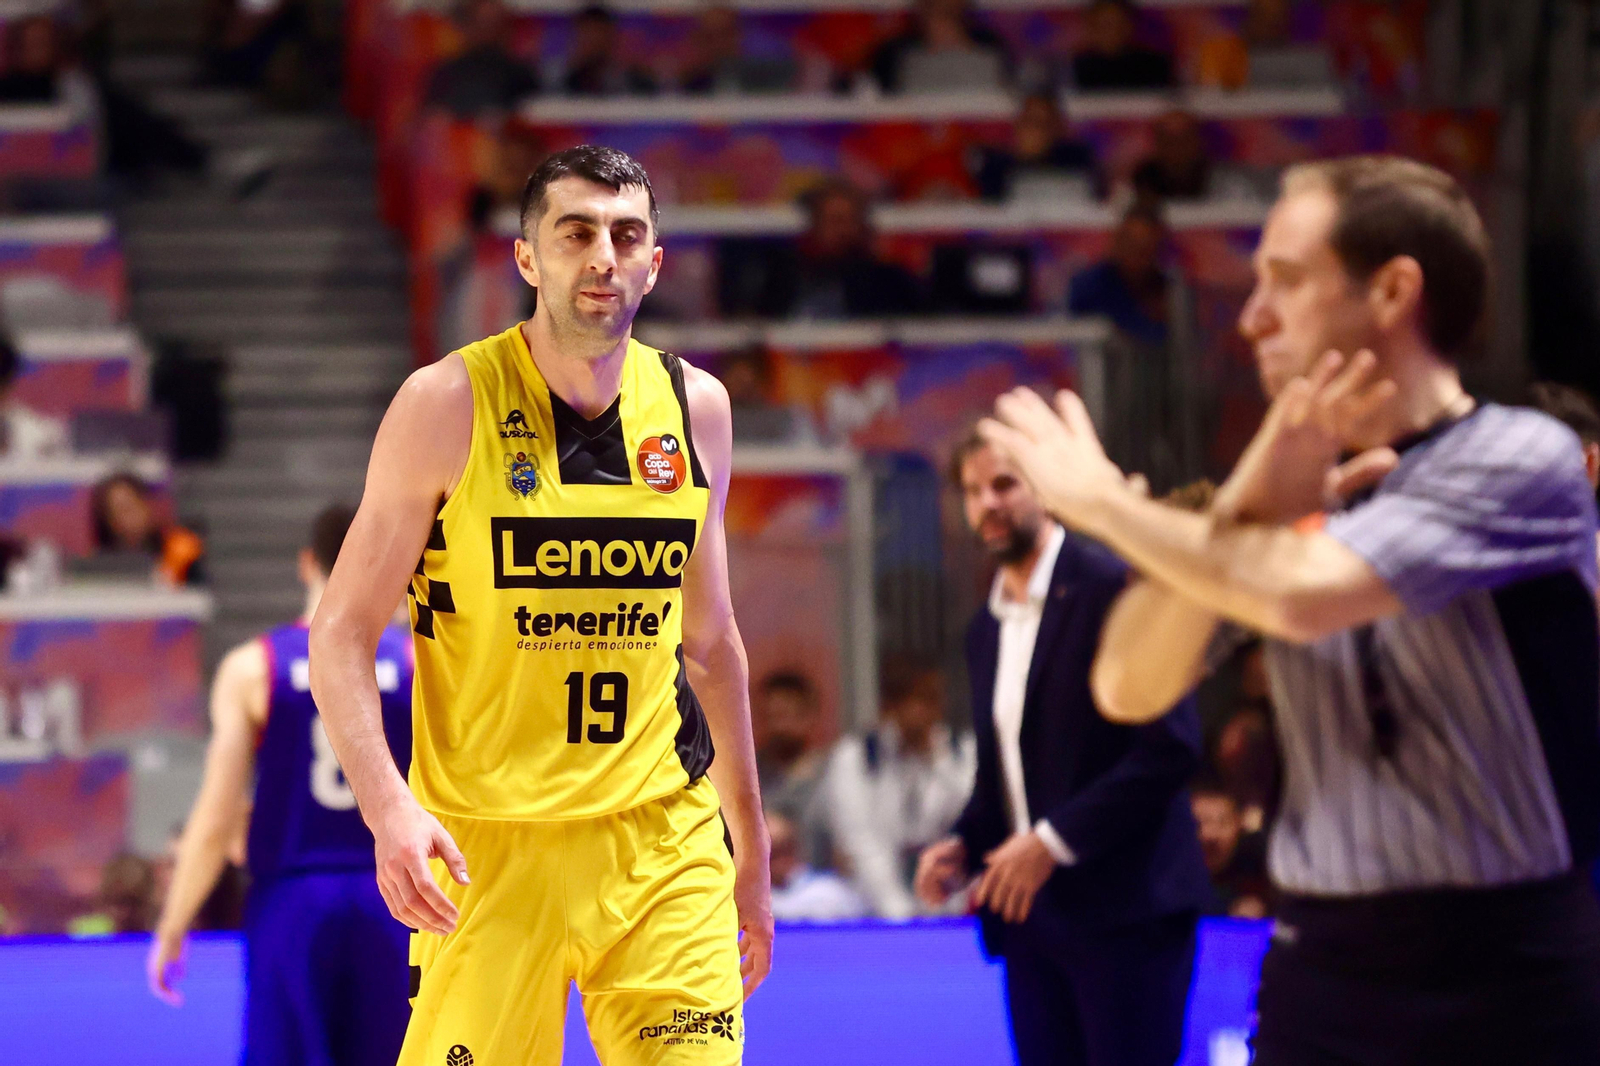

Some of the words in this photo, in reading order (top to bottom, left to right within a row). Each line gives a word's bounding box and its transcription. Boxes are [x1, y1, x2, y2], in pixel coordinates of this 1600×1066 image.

[644, 459, 670, 469] Copa
[658, 468, 675, 479] Rey
[502, 530, 688, 577] Lenovo
[517, 638, 581, 652] despierta
[564, 671, 629, 744] 19
[673, 1009, 711, 1023] Islas
[695, 1038, 708, 1046] VIDA
